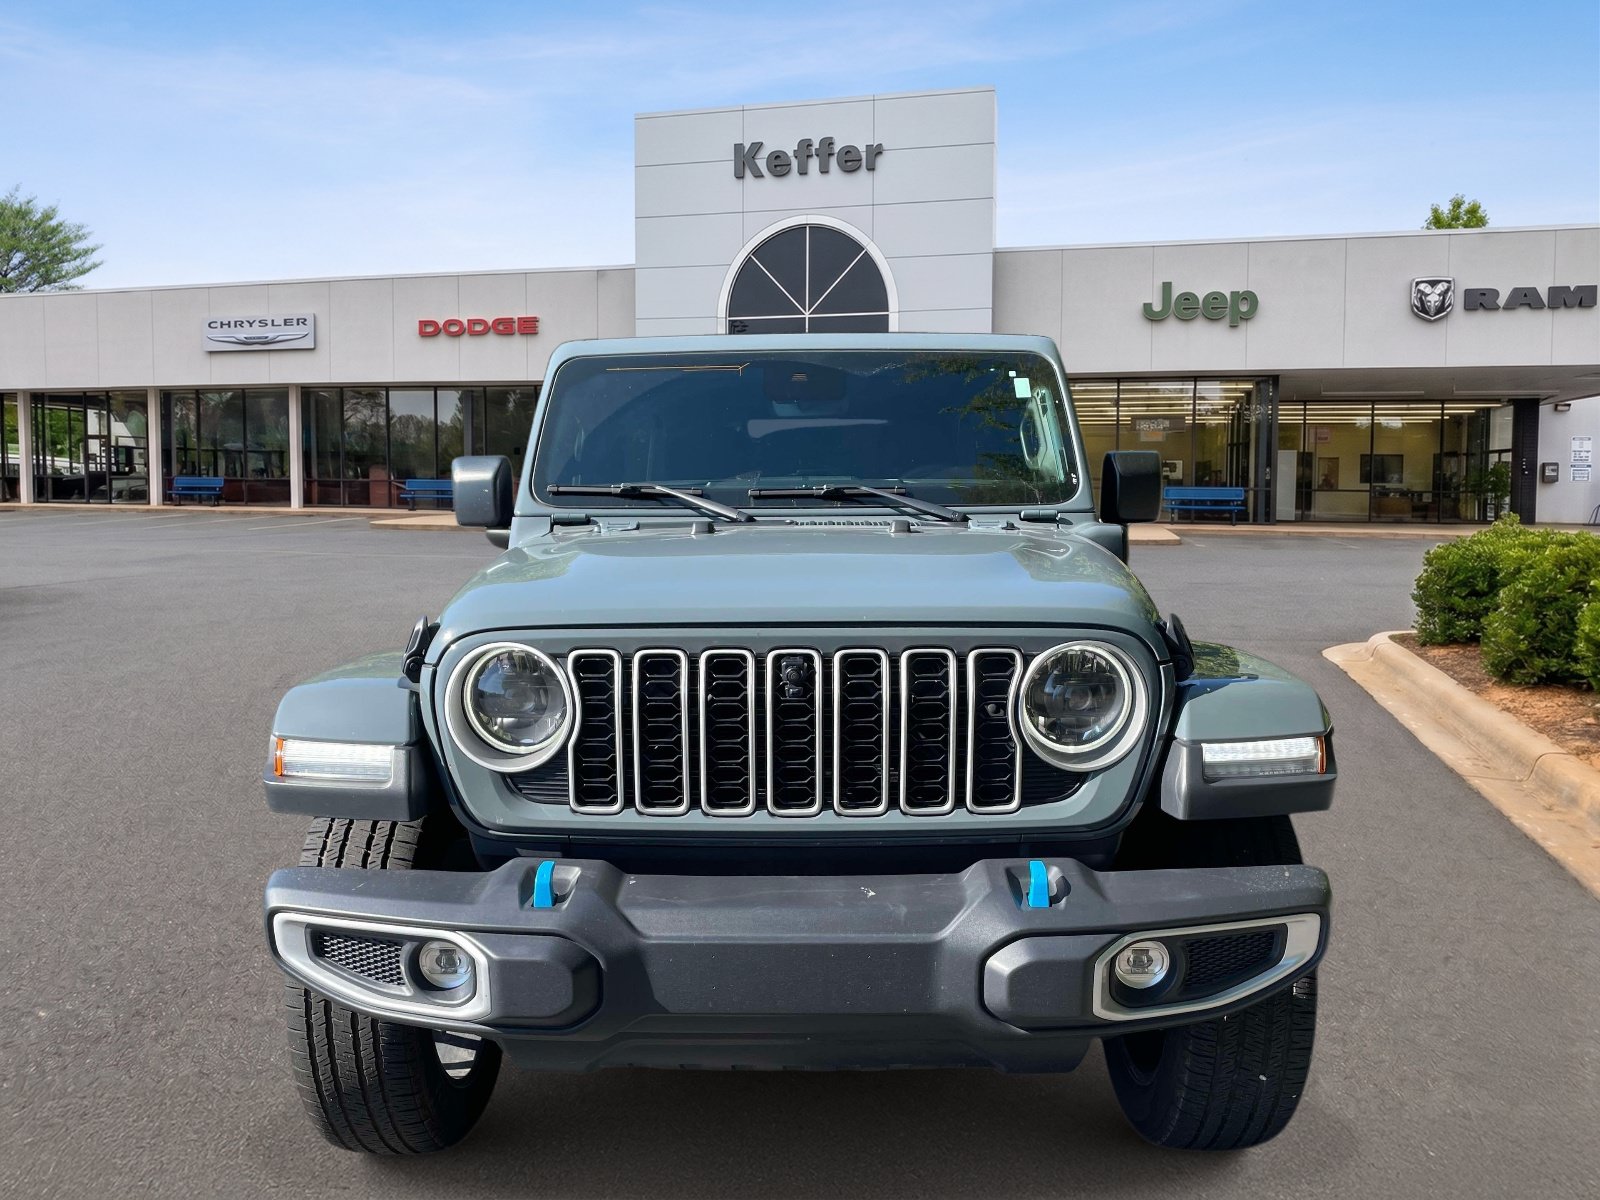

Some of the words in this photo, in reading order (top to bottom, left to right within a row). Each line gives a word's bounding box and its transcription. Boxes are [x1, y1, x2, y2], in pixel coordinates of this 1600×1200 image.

[733, 136, 884, 179] Keffer
[1143, 281, 1260, 327] Jeep
[1463, 285, 1598, 311] RAM
[207, 317, 309, 330] CHRYSLER
[418, 316, 540, 337] DODGE
